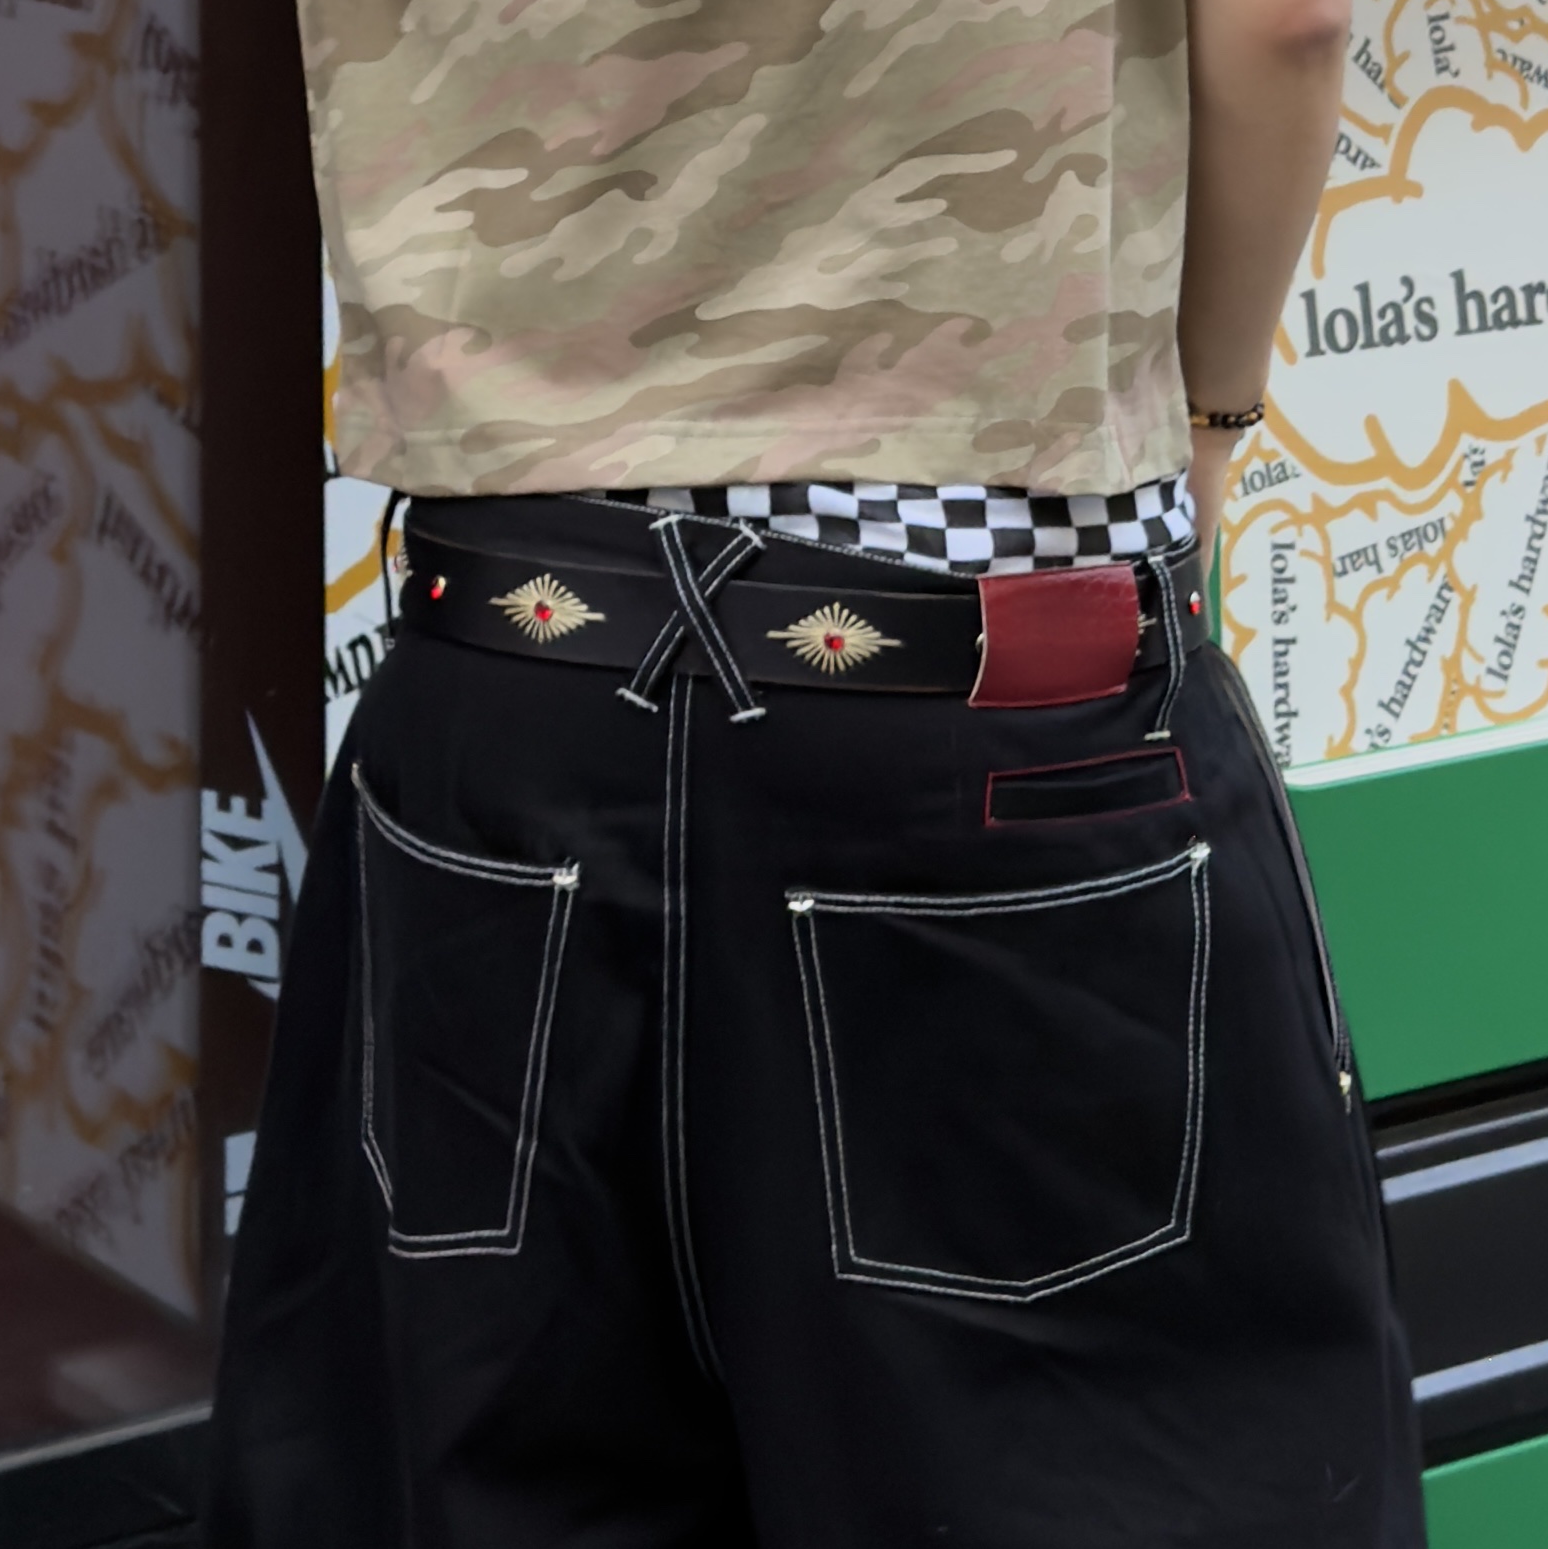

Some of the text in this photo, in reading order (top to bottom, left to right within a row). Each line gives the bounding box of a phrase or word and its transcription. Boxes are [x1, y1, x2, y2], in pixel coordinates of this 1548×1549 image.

[1300, 275, 1440, 360] lola's
[1270, 541, 1300, 626] lola's
[1484, 599, 1527, 685] lola's
[200, 787, 281, 972] BIKE
